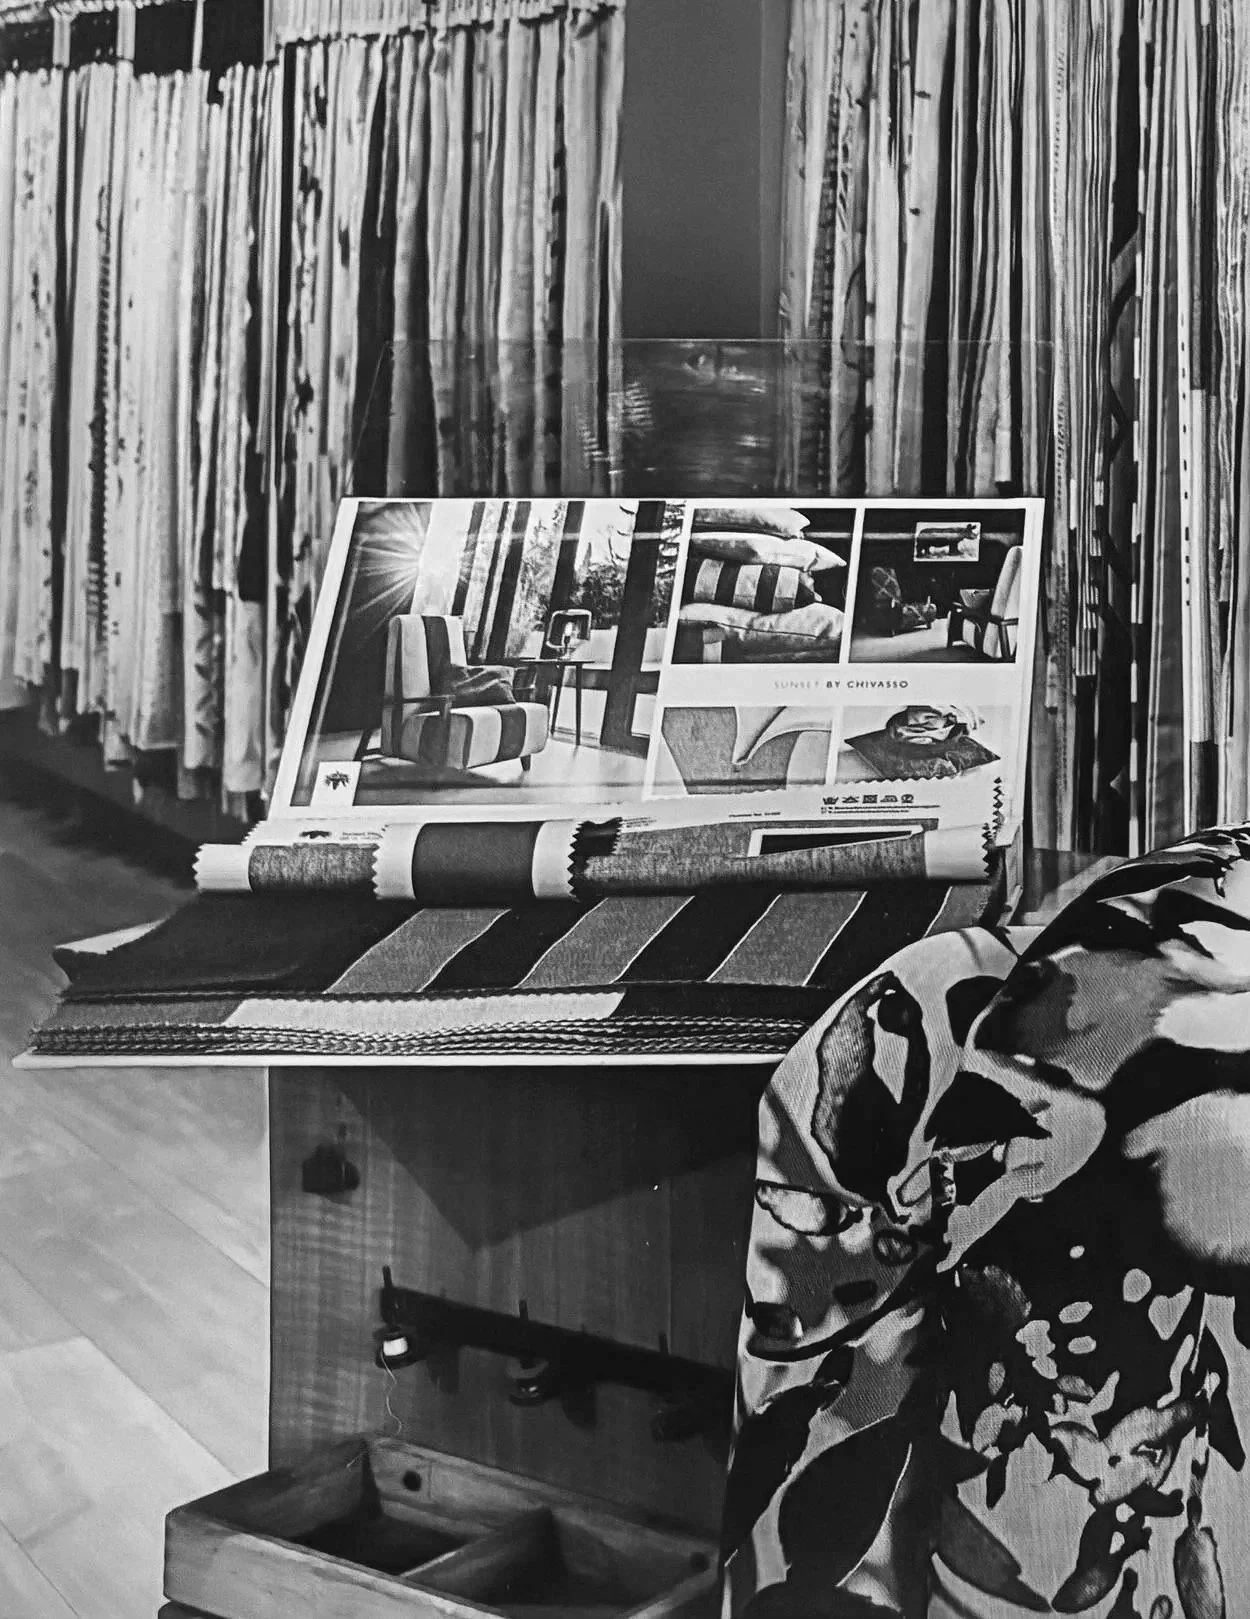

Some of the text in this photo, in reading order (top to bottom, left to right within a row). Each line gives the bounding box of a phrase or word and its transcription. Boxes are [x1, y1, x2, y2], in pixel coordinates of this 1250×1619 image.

[774, 680, 909, 689] SUNSET BY CHIVASSO
